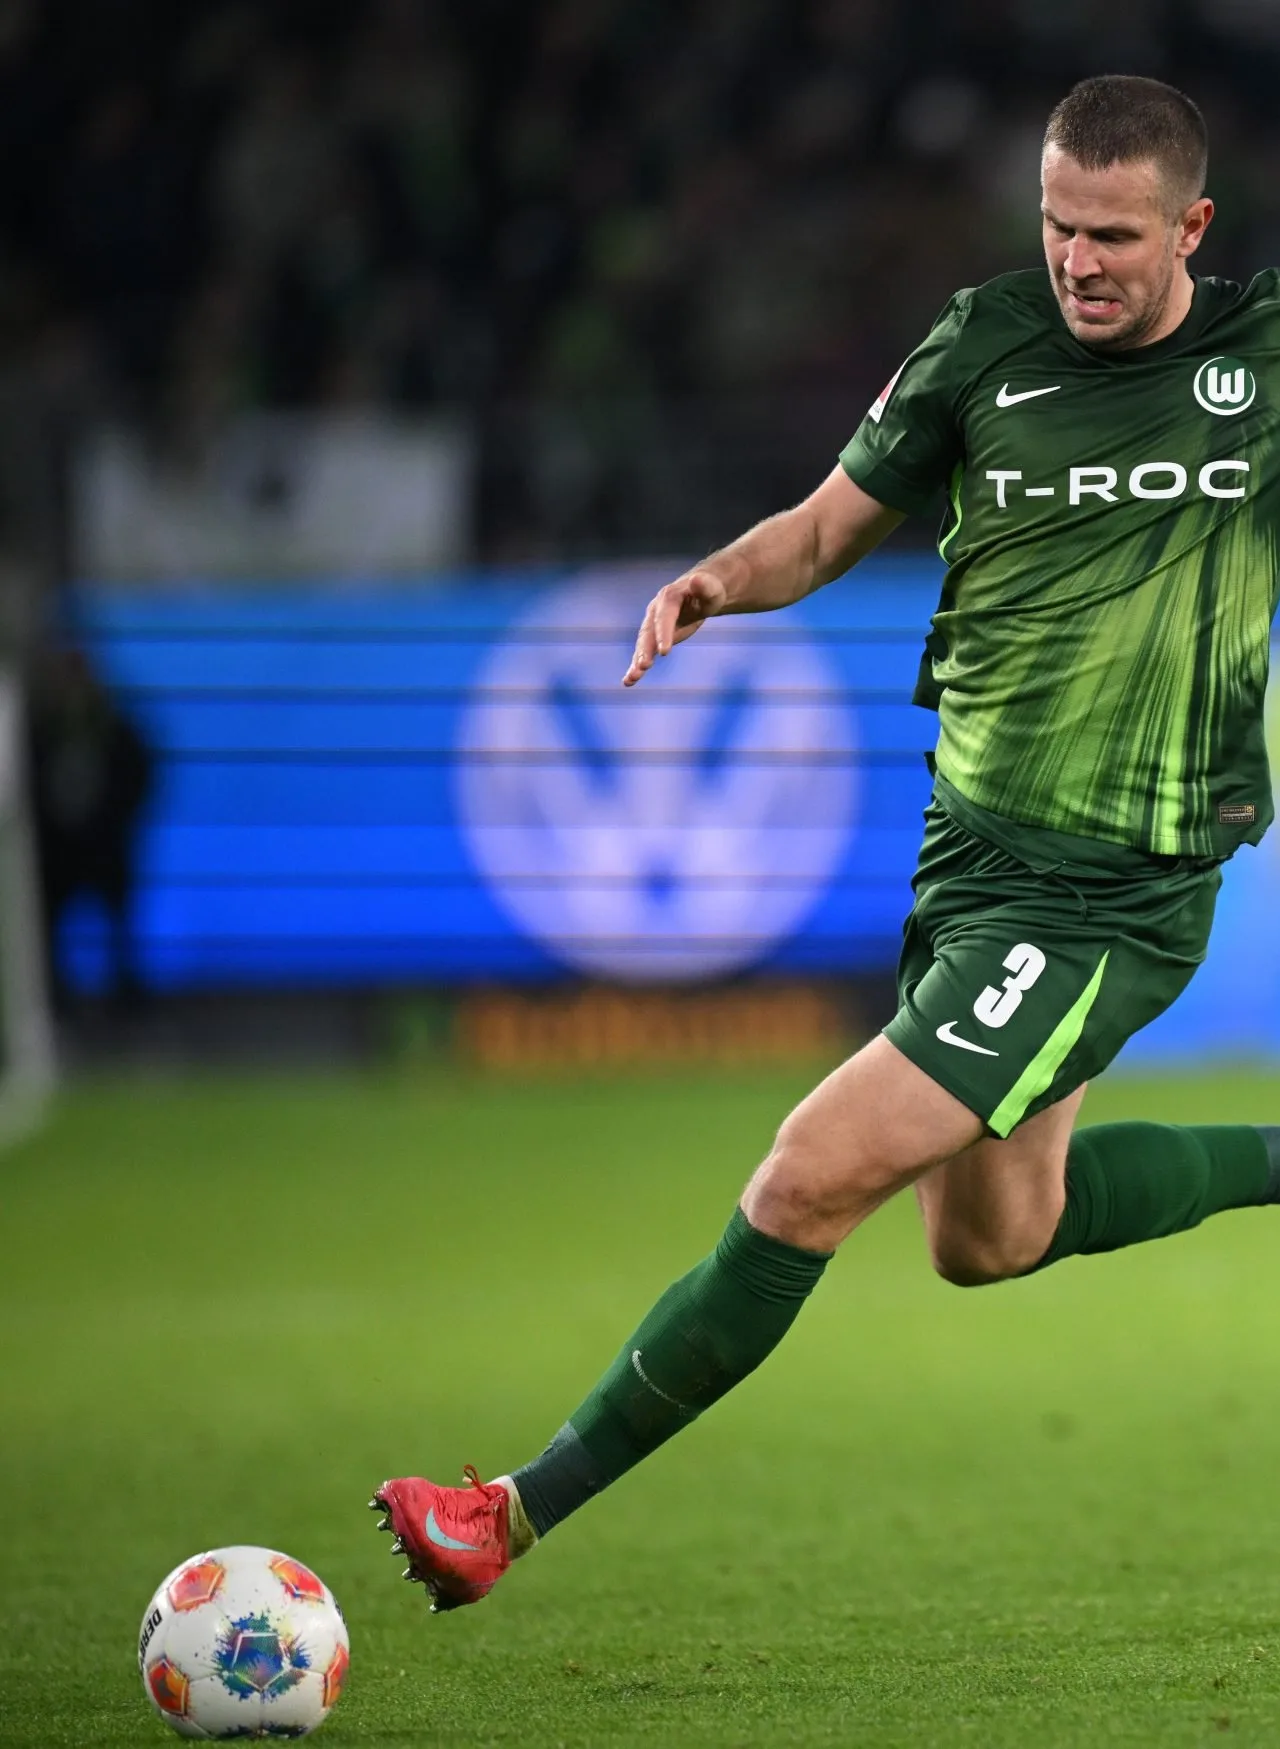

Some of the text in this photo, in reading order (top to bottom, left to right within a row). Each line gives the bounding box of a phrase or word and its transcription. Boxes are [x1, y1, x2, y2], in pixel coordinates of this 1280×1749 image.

[1207, 366, 1245, 403] W
[985, 459, 1250, 508] T-ROC
[973, 942, 1046, 1028] 3
